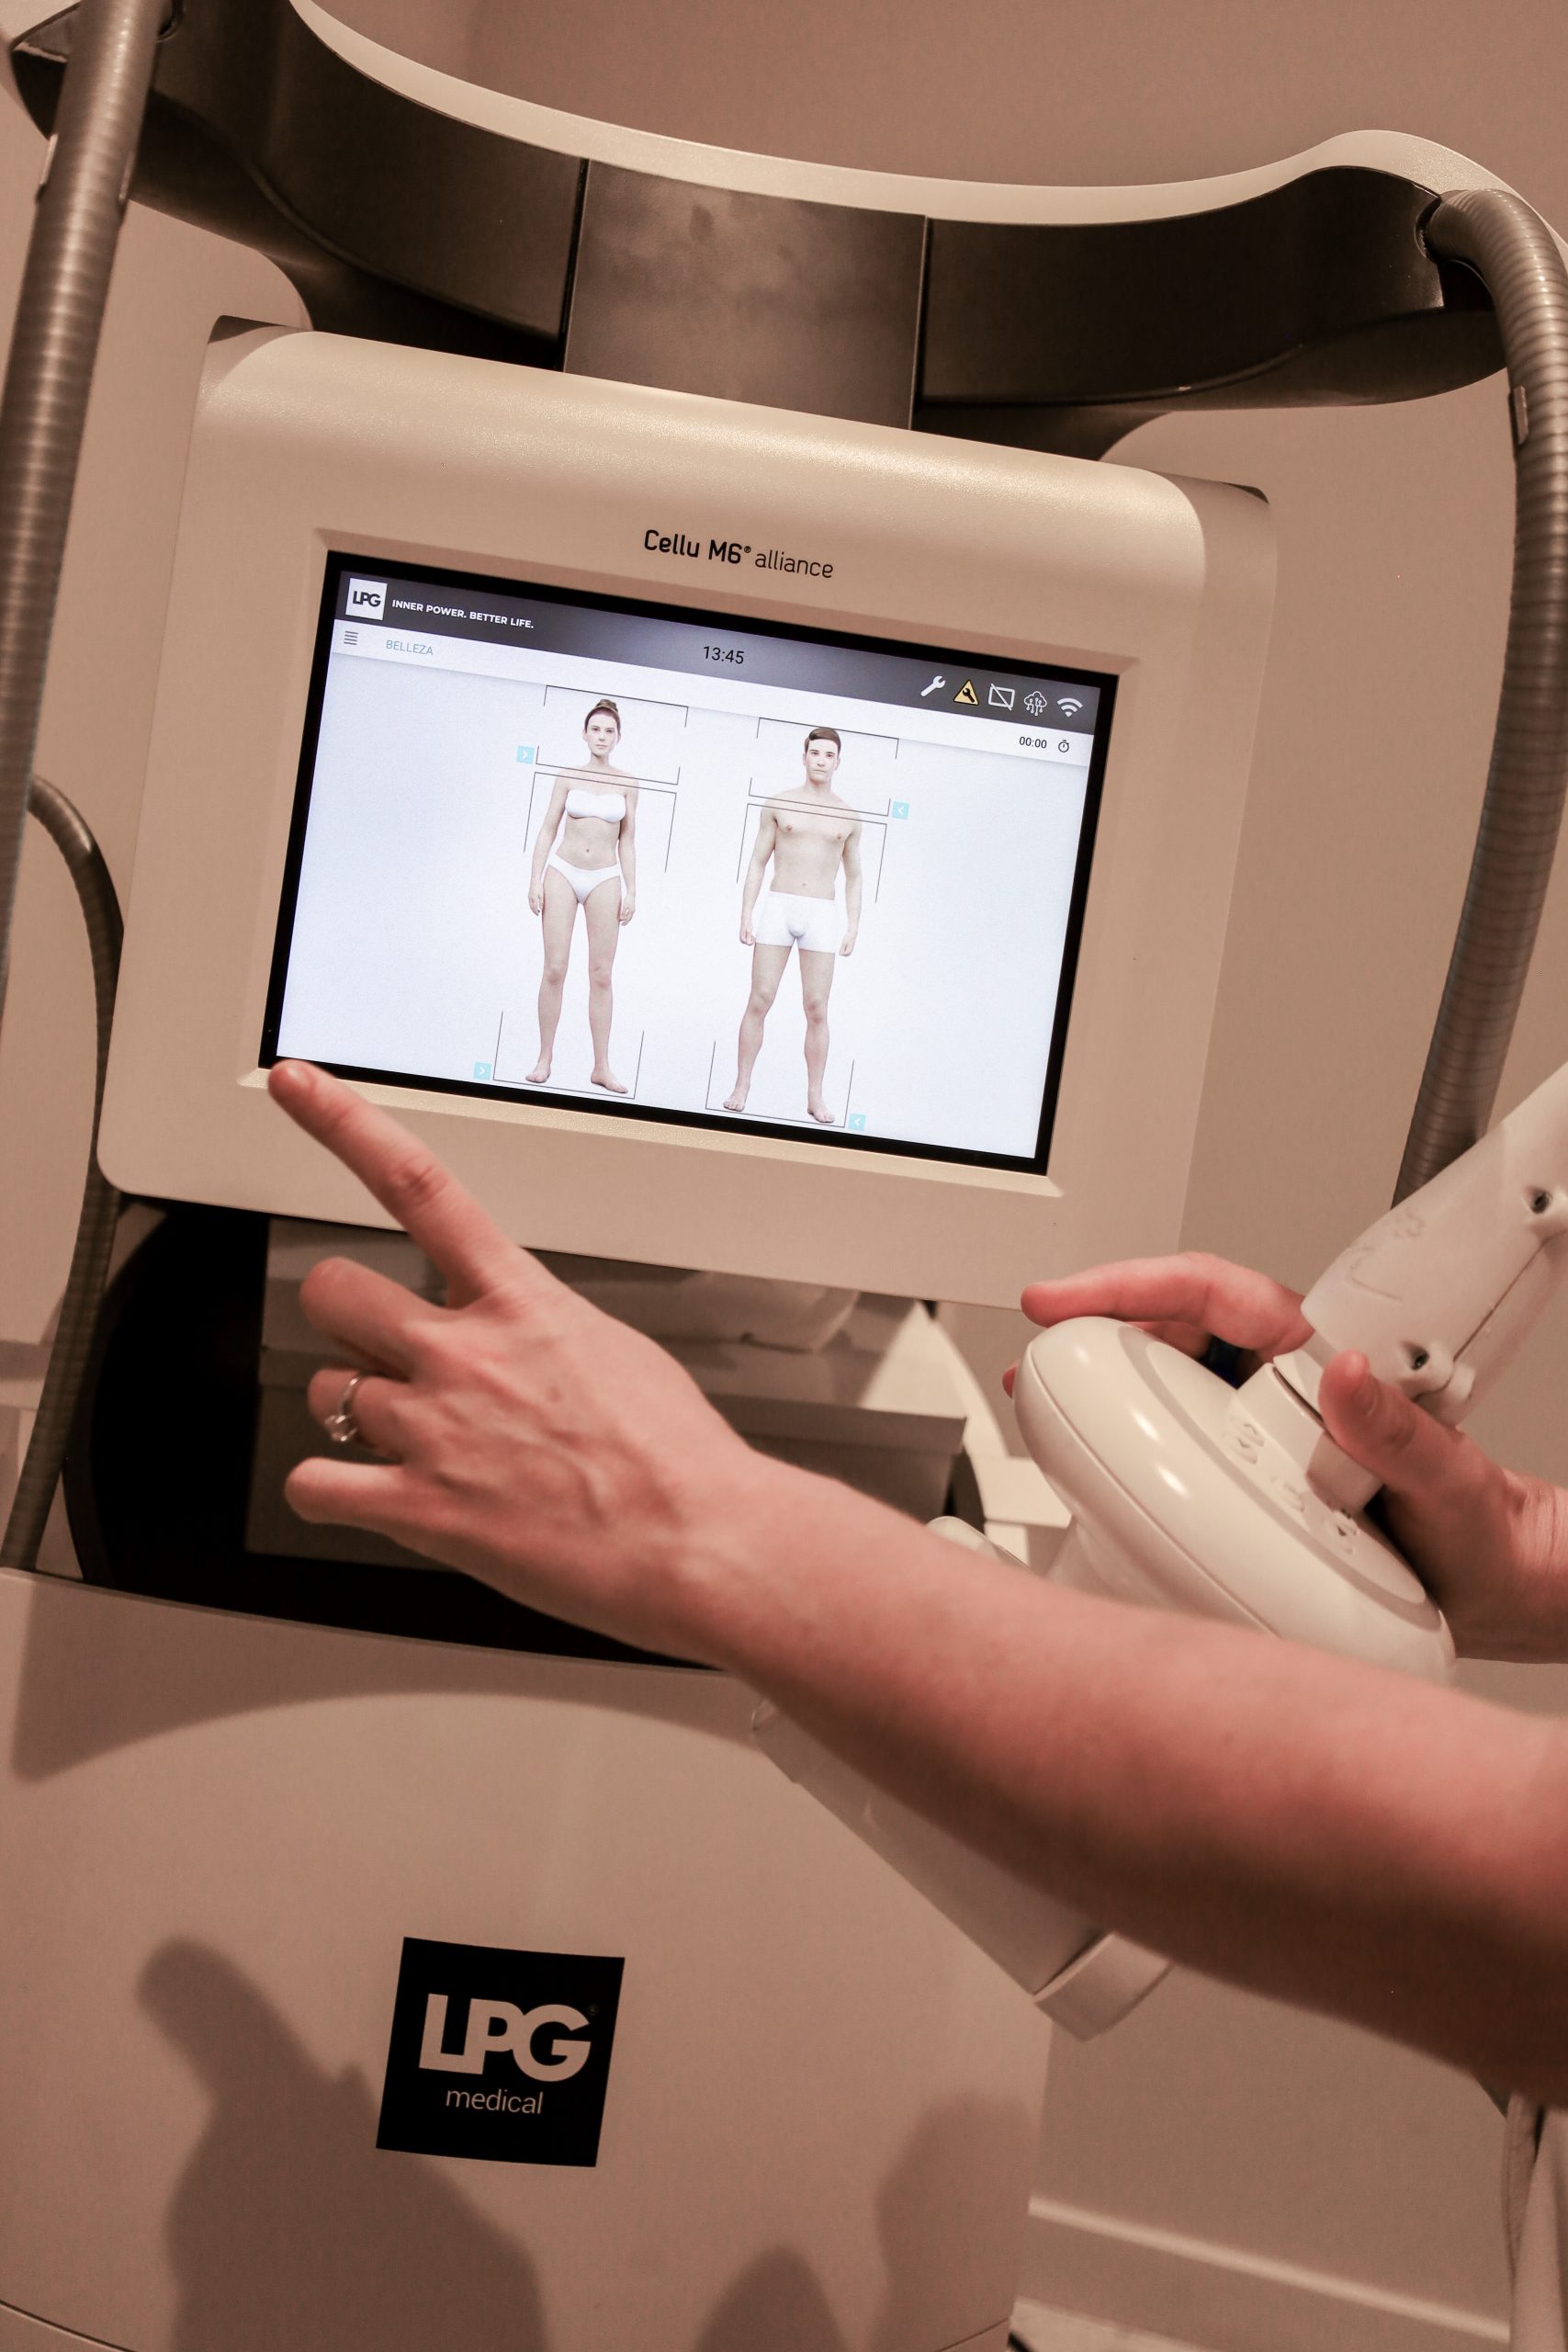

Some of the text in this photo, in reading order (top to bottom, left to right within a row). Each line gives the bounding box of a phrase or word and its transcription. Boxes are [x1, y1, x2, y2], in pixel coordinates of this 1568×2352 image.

[644, 529, 700, 558] Cellu
[755, 549, 834, 579] alliance
[352, 590, 382, 607] LPG
[391, 599, 535, 629] INNER POWER. BETTER LIFE.
[386, 639, 434, 657] BELLEZA
[703, 646, 745, 665] 13:45
[1019, 736, 1048, 750] 00:00
[419, 1993, 592, 2083] LPG
[446, 2088, 544, 2115] medical
